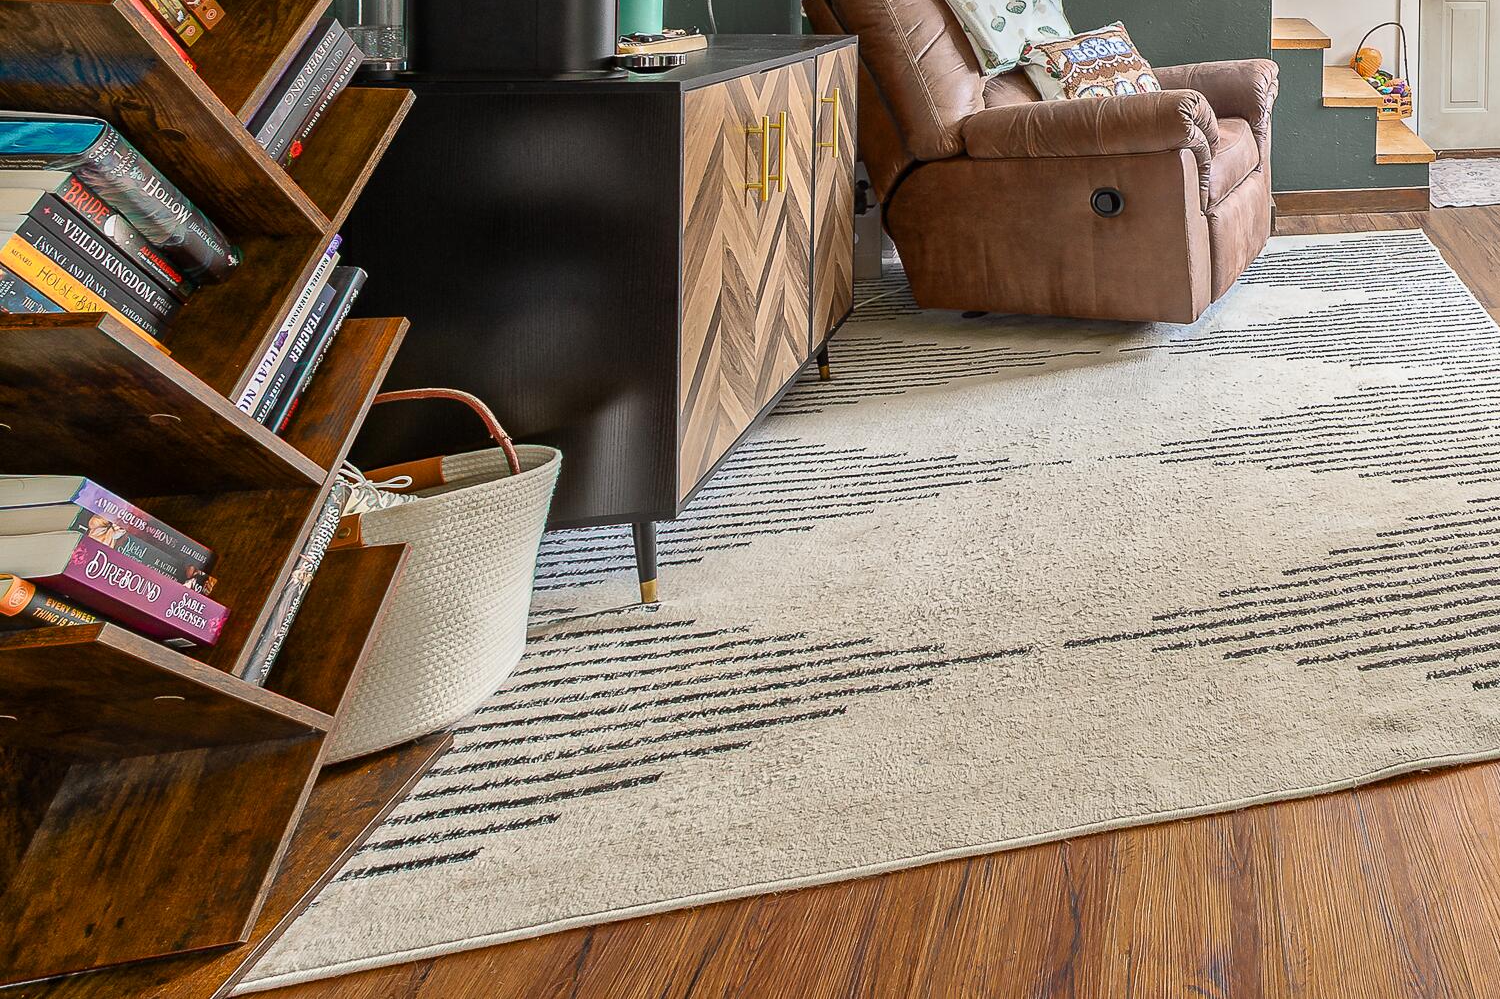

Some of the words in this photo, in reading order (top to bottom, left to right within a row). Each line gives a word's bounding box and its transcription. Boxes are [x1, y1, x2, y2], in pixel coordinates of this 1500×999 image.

[324, 31, 336, 49] THE
[304, 45, 325, 75] EVER
[284, 74, 307, 105] KING
[64, 177, 111, 225] BRIDE
[142, 175, 193, 226] HOLLOW
[33, 235, 70, 270] ESSENCE
[68, 262, 85, 280] AND
[83, 273, 109, 299] RUNES
[52, 213, 65, 227] THE
[63, 218, 106, 262] VEILED
[101, 254, 158, 304] KINGDOM
[309, 257, 329, 291] RACHEL
[36, 265, 74, 300] HOUSE
[156, 295, 174, 310] HOLLY
[287, 288, 312, 329] HARRISON
[120, 304, 142, 327] TAYLOR
[141, 319, 158, 337] LYNN
[288, 312, 322, 364] TEACHER
[254, 346, 280, 385] PLAY
[268, 373, 286, 400] FREIDA
[95, 497, 118, 515] AMID
[117, 507, 147, 531] CLOUDS
[154, 527, 178, 548] BONES
[302, 506, 340, 572] SPARROWS
[153, 557, 179, 576] RACHEL
[180, 544, 193, 556] ELLA
[191, 549, 208, 565] FIELDS
[85, 549, 162, 604] DIREBOUND
[32, 607, 58, 624] THING
[45, 597, 72, 616] EVERY
[71, 607, 97, 624] SWEET
[165, 602, 208, 631] SORENSEN
[180, 591, 206, 615] SABLE
